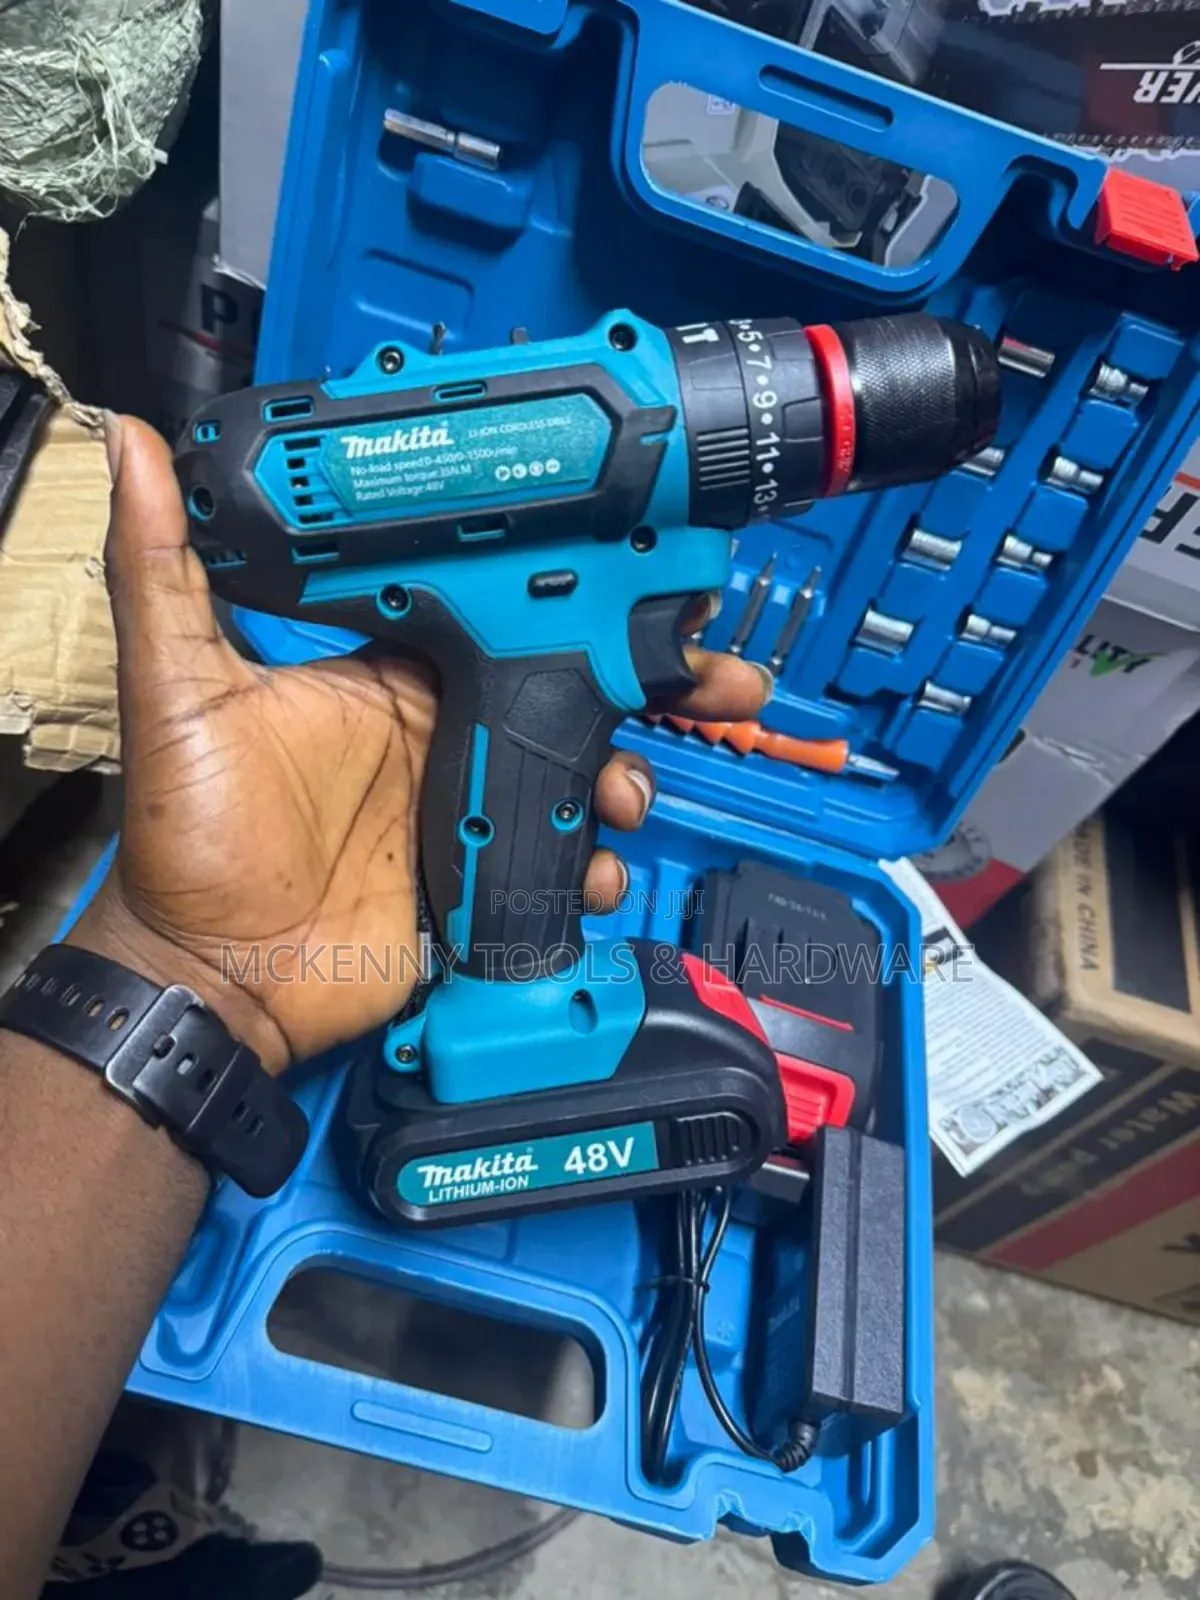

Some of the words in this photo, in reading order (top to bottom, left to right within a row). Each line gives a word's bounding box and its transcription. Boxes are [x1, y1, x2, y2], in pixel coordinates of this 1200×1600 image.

[1077, 903, 1100, 971] CHINA
[564, 1137, 634, 1175] 48V
[428, 1175, 528, 1203] LITHIUM-ION
